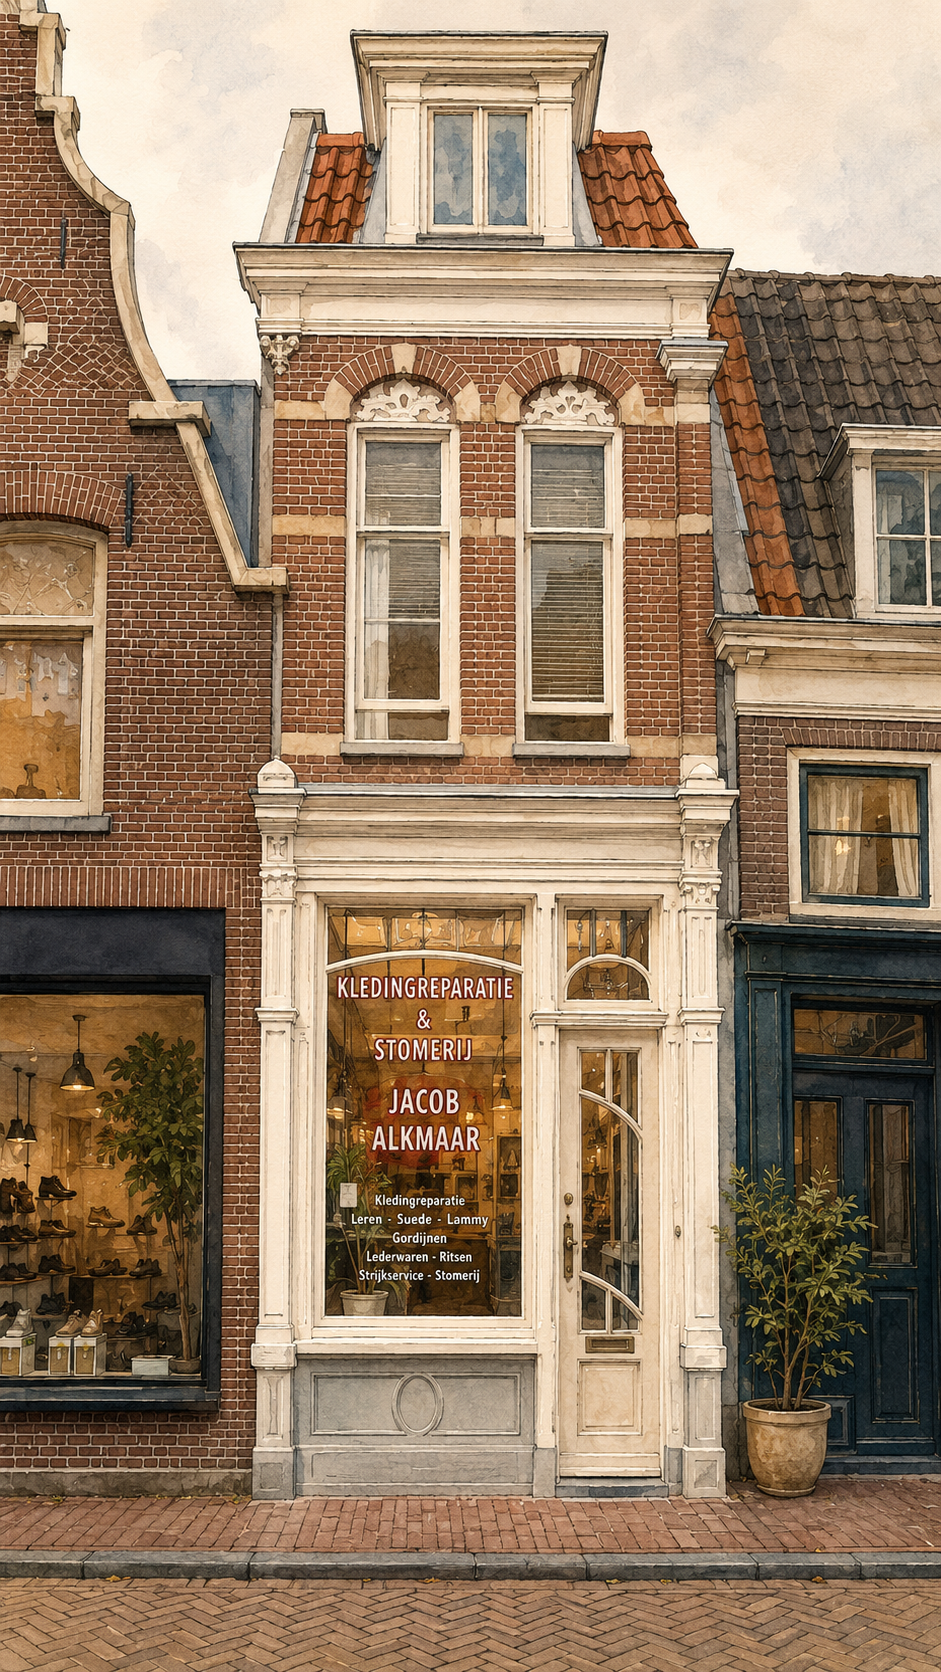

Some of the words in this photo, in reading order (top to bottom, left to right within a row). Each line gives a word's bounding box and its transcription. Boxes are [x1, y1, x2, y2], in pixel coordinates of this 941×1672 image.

[337, 976, 514, 999] KLEDINGREPARATIE
[416, 1008, 432, 1029] &
[374, 1038, 473, 1061] STOMERIJ
[388, 1088, 460, 1114] JACOB
[371, 1125, 481, 1151] ALKMAAR
[375, 1194, 466, 1209] Kledingreparatie
[351, 1213, 383, 1225] Leren
[397, 1213, 432, 1225] Suede
[447, 1213, 489, 1228] Lammy
[392, 1231, 447, 1247] Gordijnen
[366, 1251, 429, 1262] Lederwaren
[439, 1251, 473, 1262] Ritsen
[358, 1269, 424, 1283] Strijkservice
[435, 1269, 480, 1283] Stomerij
